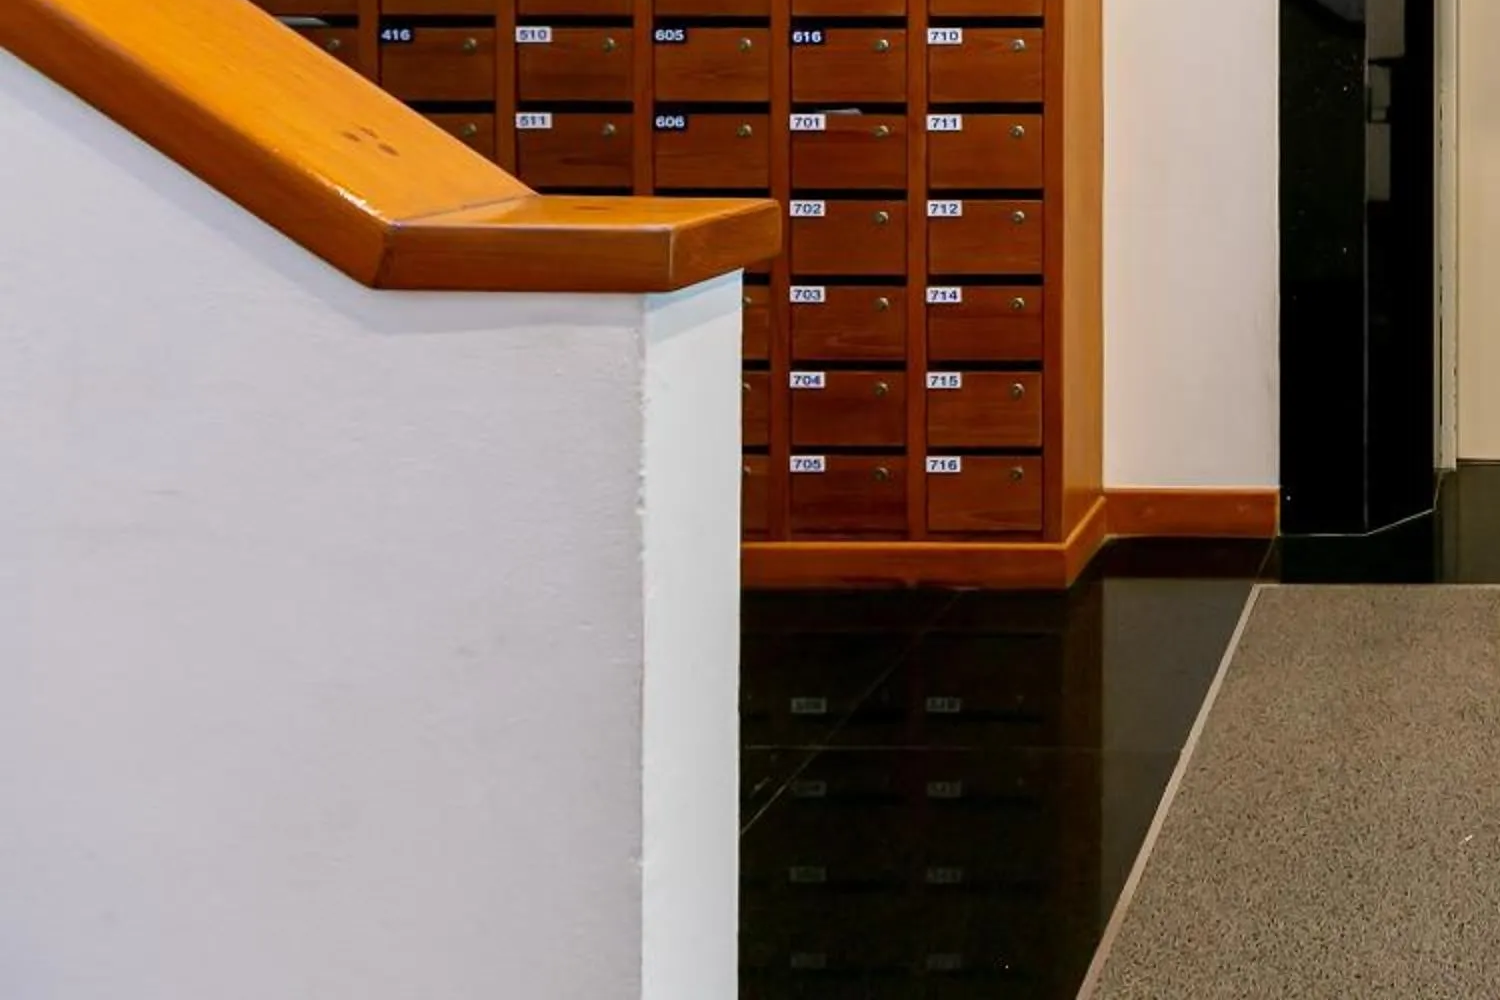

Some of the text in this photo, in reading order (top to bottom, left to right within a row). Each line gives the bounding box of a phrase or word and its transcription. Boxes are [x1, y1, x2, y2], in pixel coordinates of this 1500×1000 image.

[381, 29, 411, 41] 416
[518, 29, 548, 41] 510
[655, 29, 684, 41] 605
[792, 31, 822, 43] 616
[930, 30, 959, 42] 710
[519, 115, 547, 127] 511
[655, 115, 685, 128] 606
[793, 116, 821, 129] 701
[931, 116, 958, 129] 711
[793, 202, 822, 215] 702
[930, 202, 959, 215] 712
[793, 288, 822, 301] 703
[930, 289, 958, 302] 714
[793, 374, 822, 387] 704
[930, 374, 959, 387] 715
[793, 458, 822, 471] 705
[929, 458, 958, 471] 716
